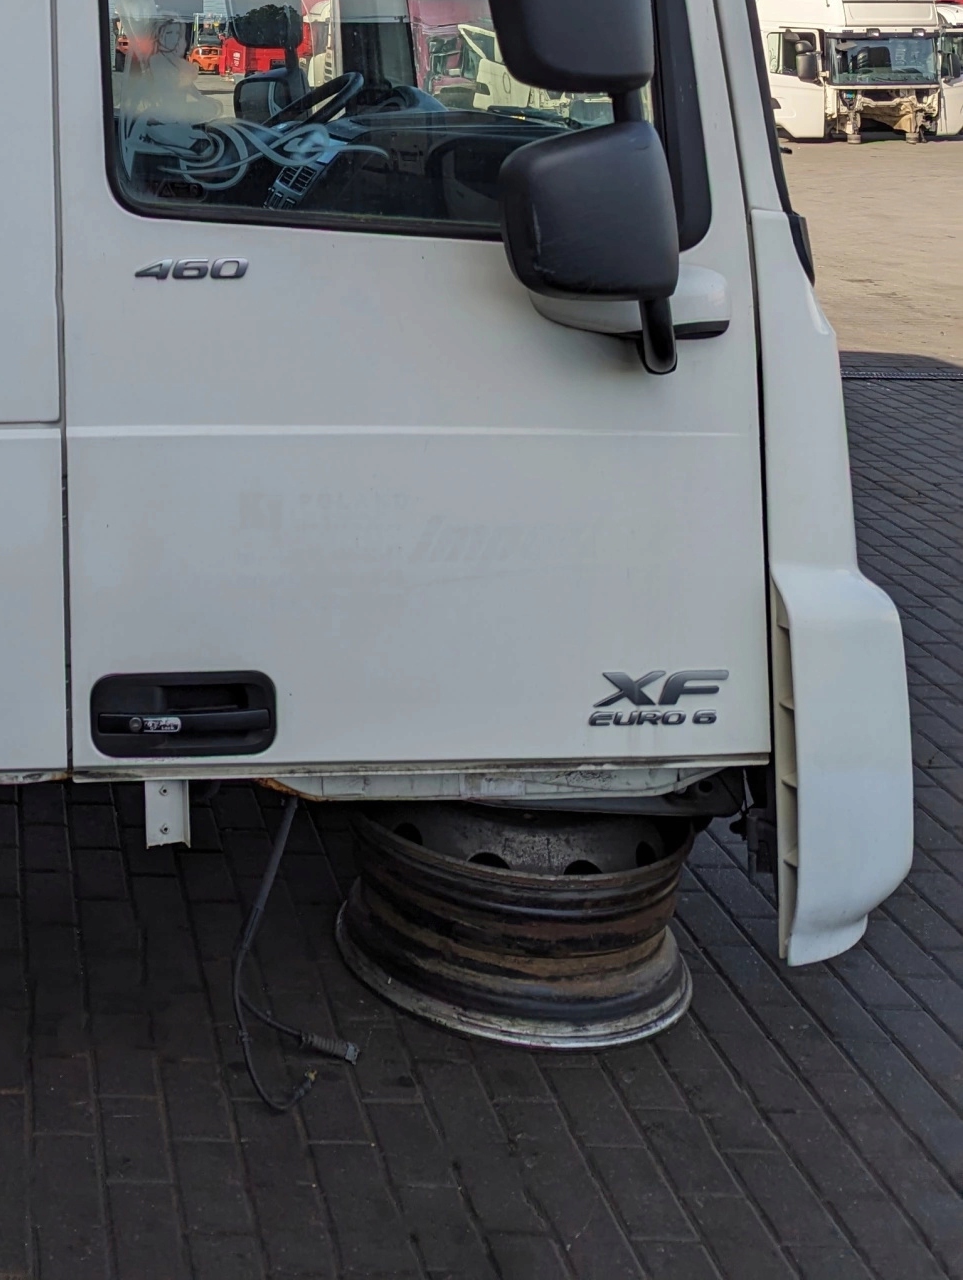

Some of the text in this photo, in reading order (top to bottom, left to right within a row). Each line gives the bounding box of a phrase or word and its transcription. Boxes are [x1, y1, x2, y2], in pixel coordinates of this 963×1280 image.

[134, 257, 249, 280] 460
[593, 669, 730, 708] XF
[588, 709, 718, 727] EURO 6
